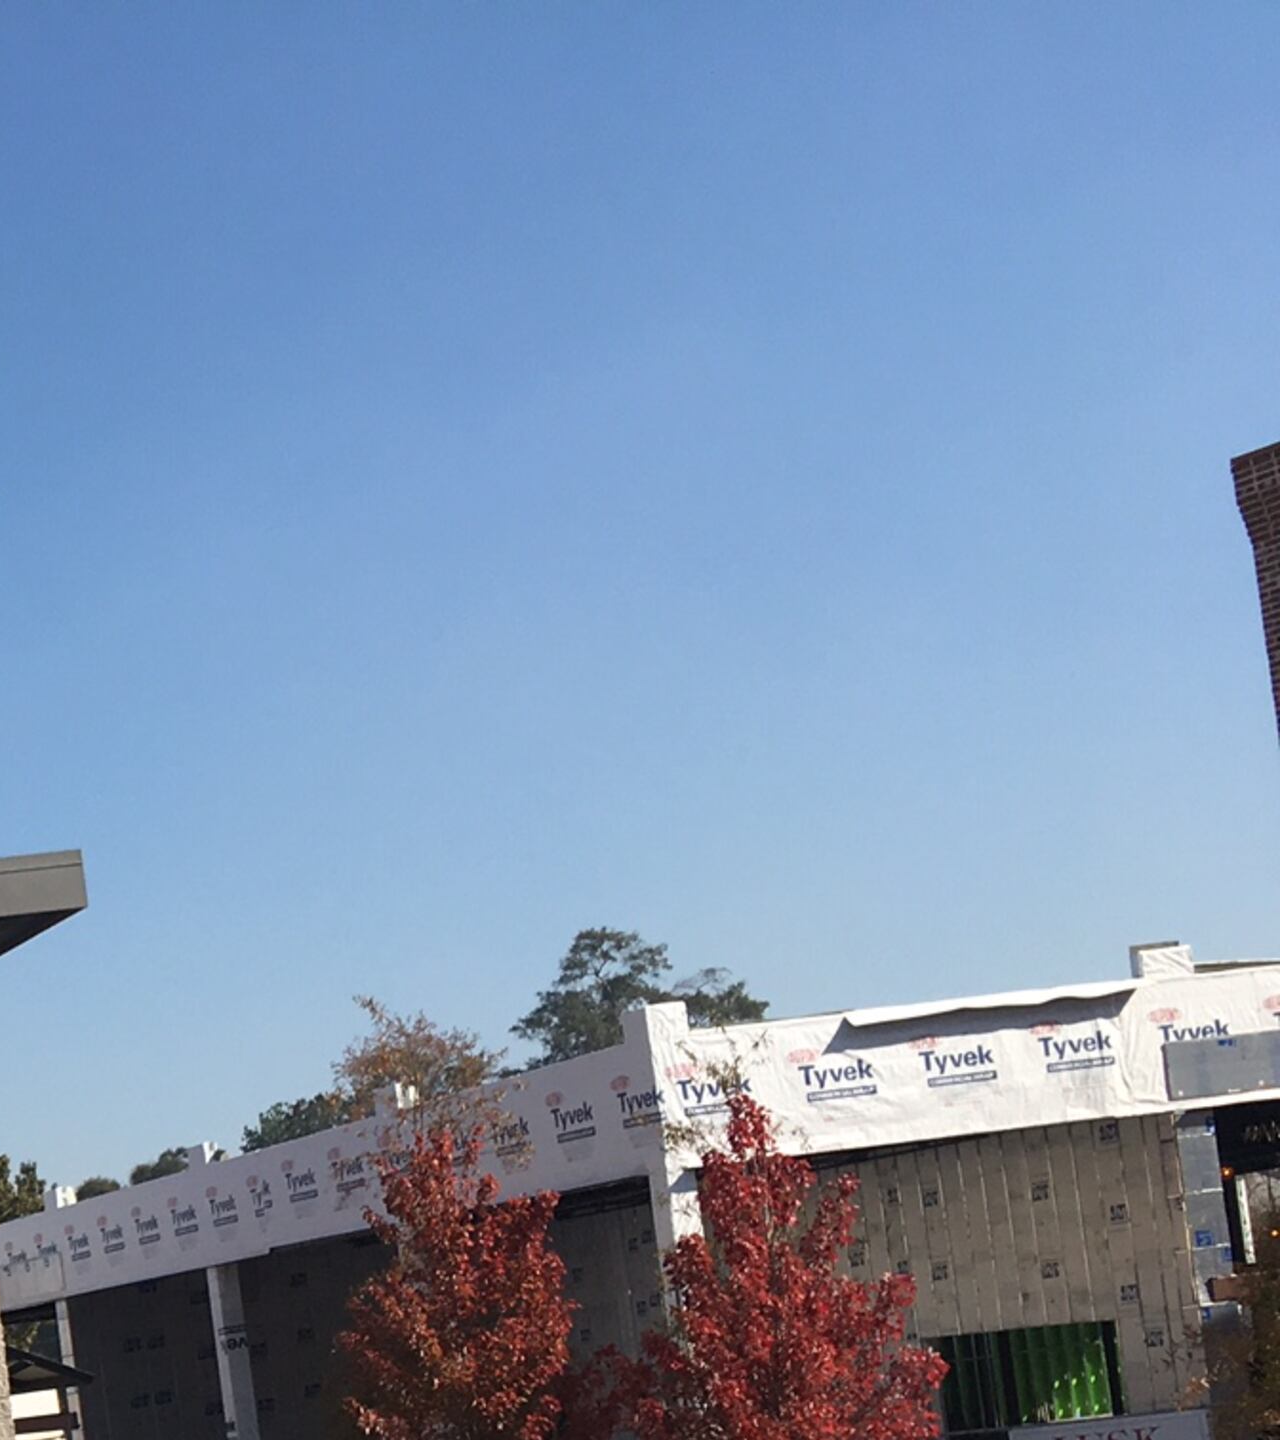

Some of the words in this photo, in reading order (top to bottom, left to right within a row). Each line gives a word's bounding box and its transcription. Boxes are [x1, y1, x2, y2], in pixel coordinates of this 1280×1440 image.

[1038, 1030, 1112, 1060] Tyvek
[798, 1058, 873, 1089] Tyvek
[918, 1044, 994, 1075] Tyvek
[616, 1086, 665, 1114] Tyvek
[677, 1077, 752, 1104] Tyvk
[550, 1101, 594, 1130] Tyvek
[285, 1168, 316, 1192] Tyvek
[170, 1204, 197, 1226] Tyvek
[209, 1195, 237, 1217] Tyvek
